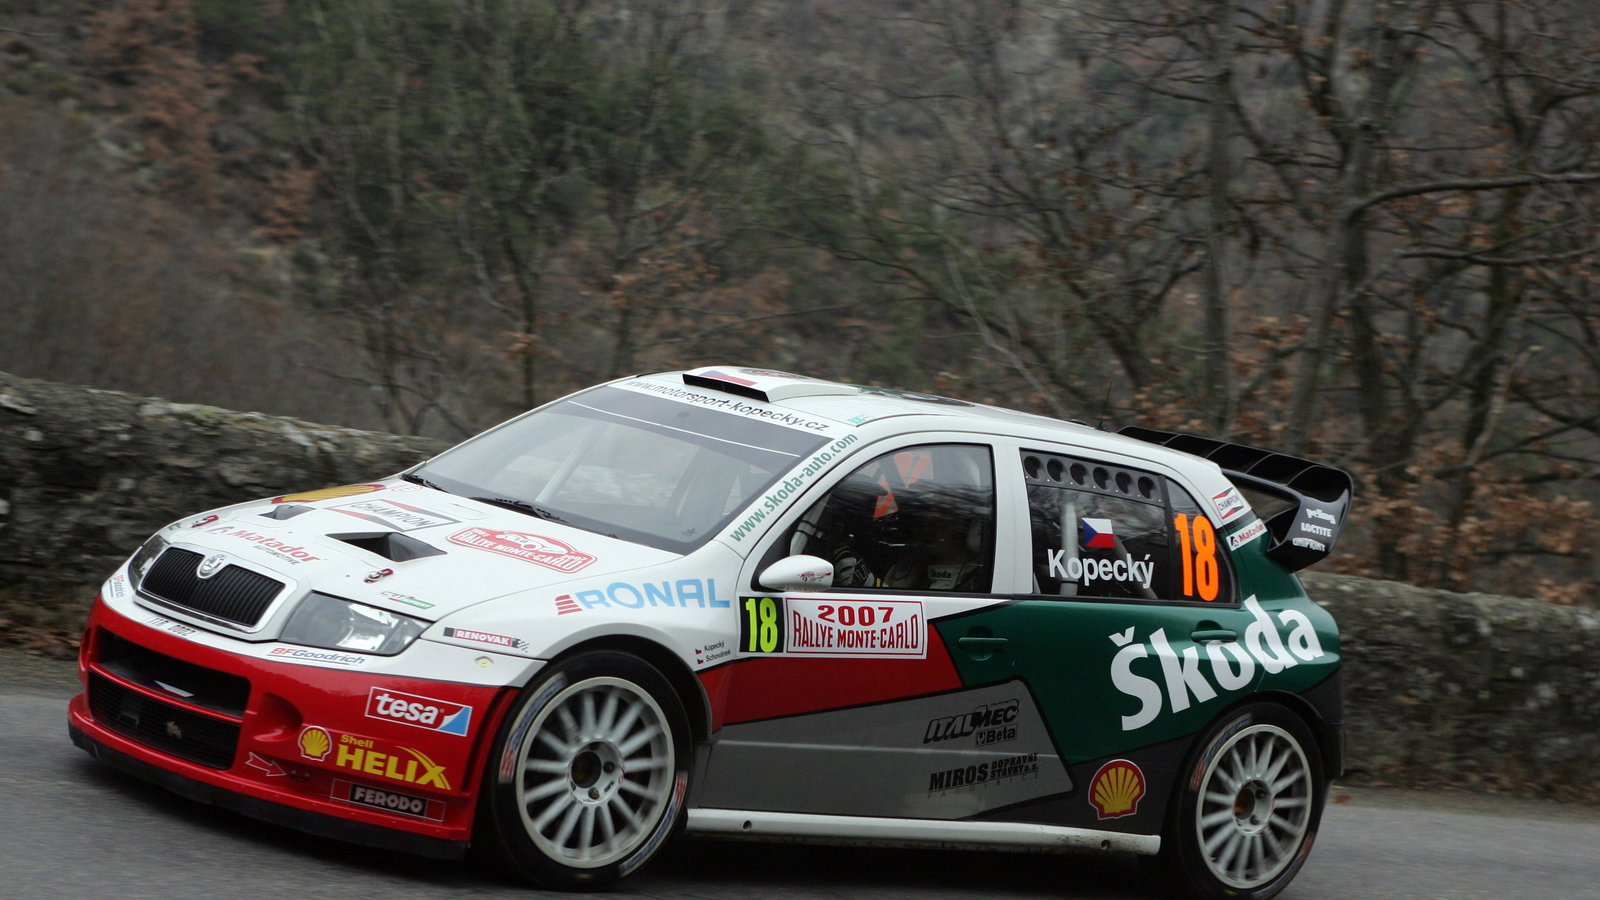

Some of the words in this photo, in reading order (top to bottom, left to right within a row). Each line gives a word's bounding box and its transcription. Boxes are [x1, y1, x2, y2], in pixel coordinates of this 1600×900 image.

[624, 380, 830, 431] www.motorsport-kopecky.cz
[730, 433, 858, 542] www.skoda-auto.com
[349, 503, 436, 527] CHAMPION
[1301, 522, 1332, 537] LOCTITE
[226, 529, 321, 562] Matador
[456, 530, 497, 549] RALLYE
[1238, 522, 1265, 541] Matador
[1047, 548, 1155, 589] Kopecký
[1174, 513, 1219, 601] 18
[574, 578, 731, 609] RONAL
[745, 597, 778, 653] 18
[793, 610, 834, 648] RALLYE
[818, 605, 894, 626] 2007
[456, 630, 510, 645] RENOVAK
[270, 647, 366, 664] BFGoodrich
[1108, 594, 1325, 732] Škoda
[375, 693, 439, 725] tesa
[923, 699, 1020, 744] ITALMEC
[340, 734, 374, 749] Shell
[986, 726, 1016, 744] Beta
[336, 744, 452, 791] HELIX
[929, 763, 989, 791] MIROS
[354, 787, 423, 813] FERODO
